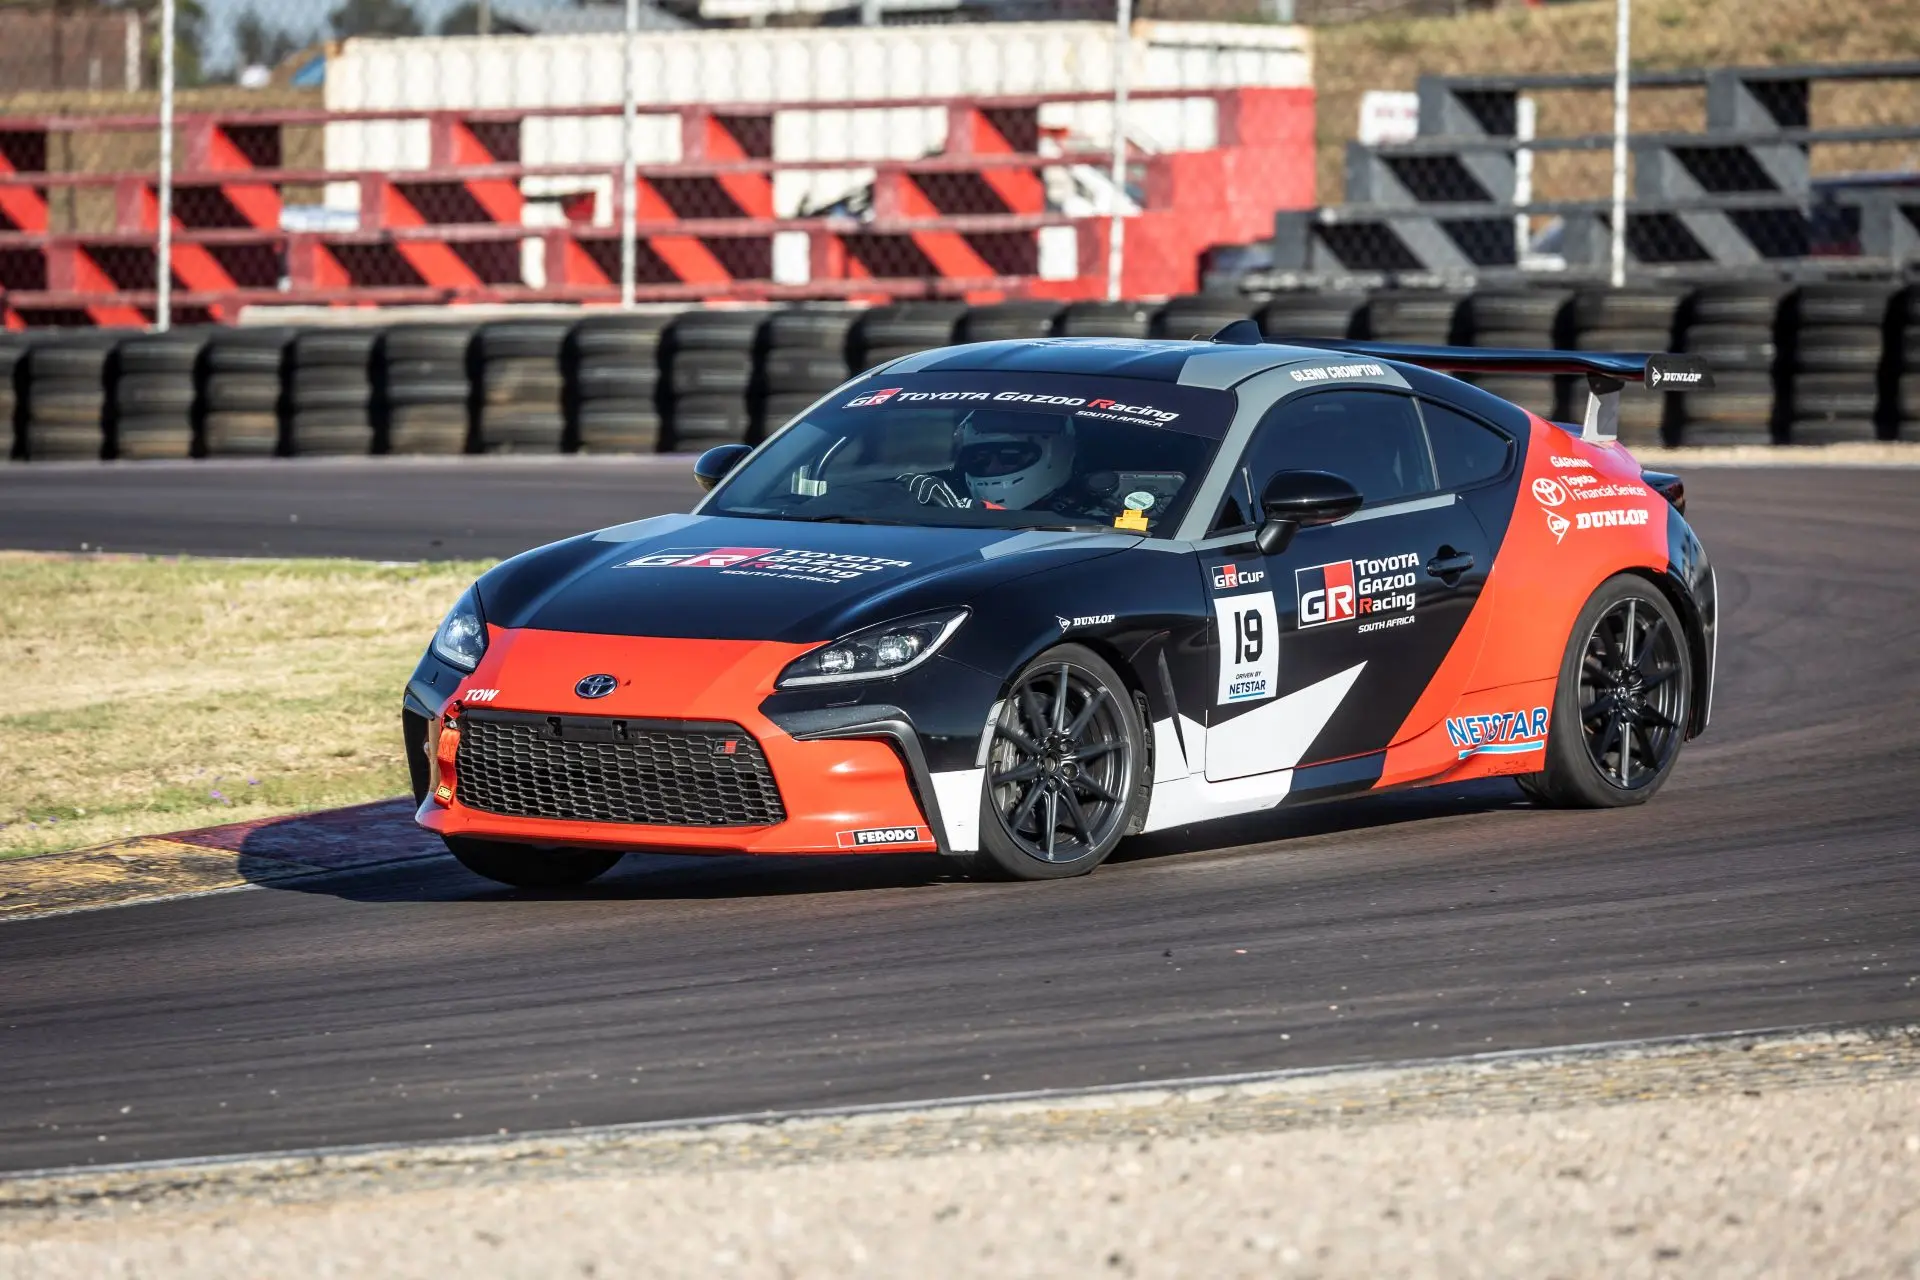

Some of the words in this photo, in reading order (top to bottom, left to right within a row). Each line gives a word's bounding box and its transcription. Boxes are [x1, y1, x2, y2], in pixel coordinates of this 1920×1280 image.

[1290, 367, 1329, 382] GLENN
[1326, 364, 1384, 379] CROMPTON
[1662, 372, 1702, 383] DUNLOP
[897, 392, 990, 402] TOYOTA
[993, 392, 1085, 406] GAZOO
[1087, 398, 1180, 422] Racing
[1075, 410, 1116, 421] SOUTH
[1119, 415, 1164, 428] AFRICA
[1550, 456, 1593, 468] GARMIN
[1562, 475, 1598, 487] Toyota
[1574, 485, 1615, 501] Financial
[1614, 484, 1647, 497] Services
[1575, 509, 1649, 530] DUNLOP
[626, 554, 750, 566] GR
[763, 556, 884, 571] GAZOO
[780, 549, 913, 568] TOYOTA
[1355, 552, 1420, 576] TOYOTA
[720, 569, 778, 579] SOUTH
[780, 573, 841, 584] AFRICA
[739, 561, 864, 579] Racing
[1358, 572, 1416, 596] GAZOO
[1300, 585, 1354, 623] GR
[1358, 592, 1416, 615] Racing
[1073, 614, 1116, 626] DUNLOP
[1358, 620, 1386, 634] SOUTH
[1386, 615, 1415, 629] AFRICA
[1234, 608, 1263, 665] 19
[1235, 672, 1254, 680] DRIVEN
[1254, 670, 1261, 678] BY
[464, 688, 500, 702] TOW
[1229, 679, 1266, 695] NETSTAR
[1445, 707, 1549, 746] NETSTAR
[857, 828, 916, 844] FERODO
